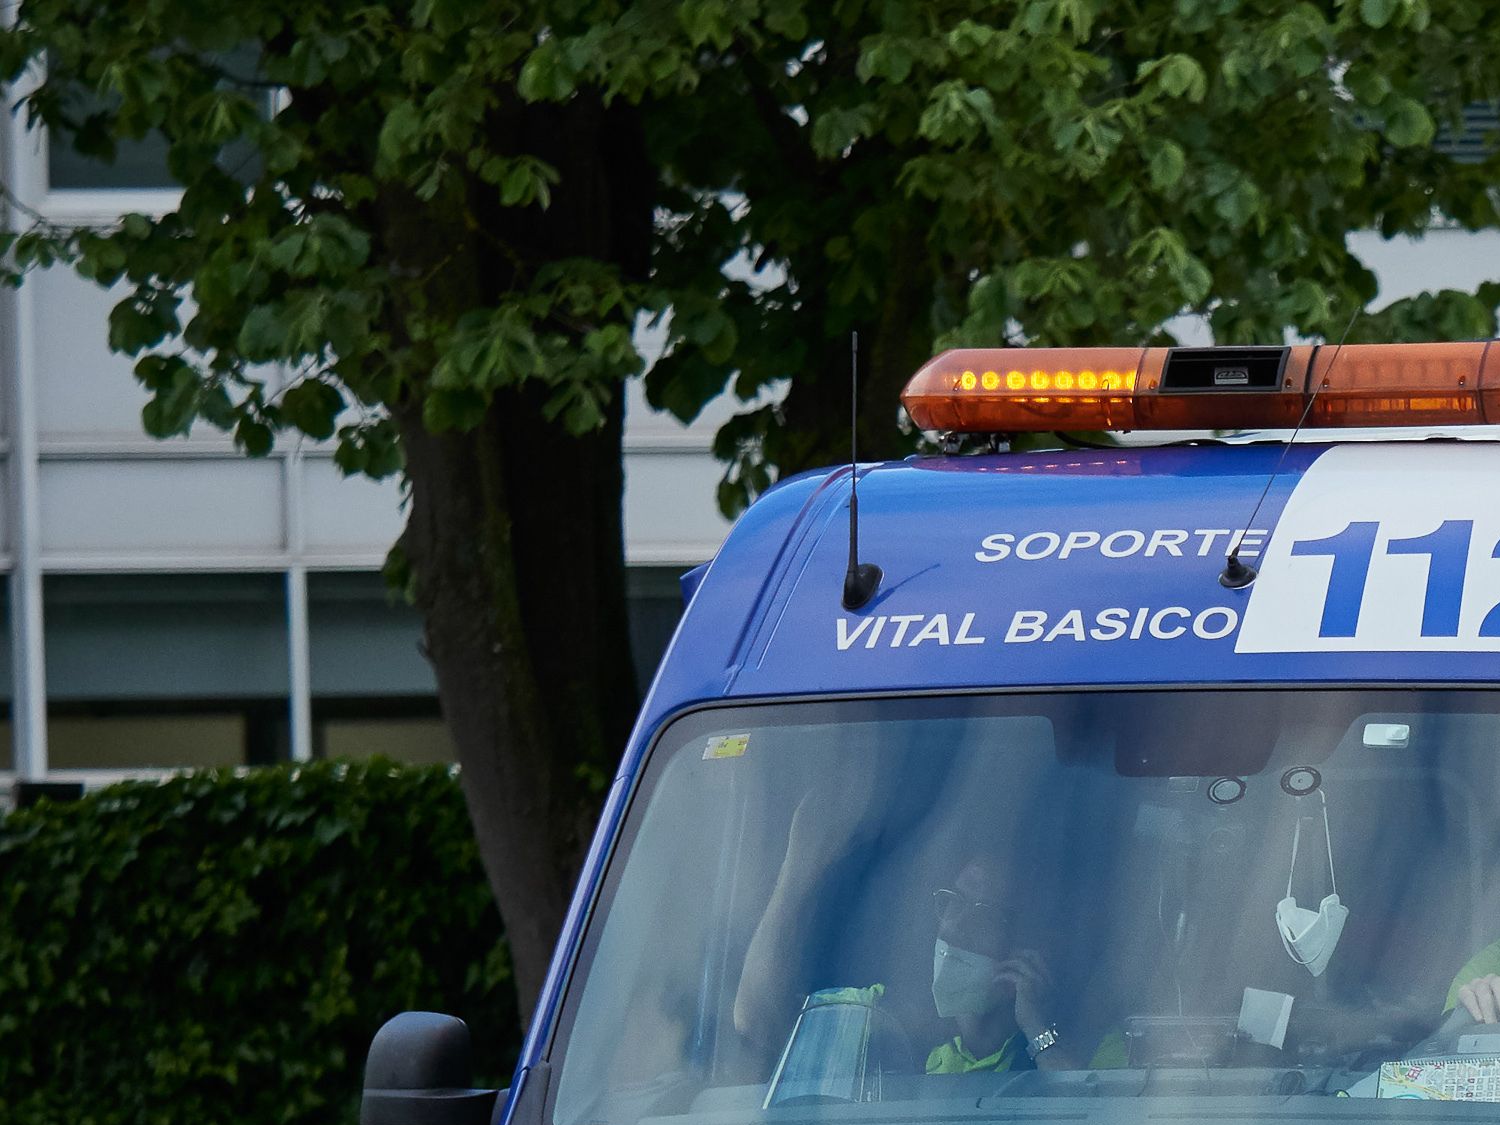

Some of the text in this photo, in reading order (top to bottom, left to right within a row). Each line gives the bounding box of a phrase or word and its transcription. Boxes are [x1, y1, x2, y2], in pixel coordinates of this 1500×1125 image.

[974, 528, 1269, 563] SOPORTE
[835, 606, 1239, 652] VITAL BASICO
